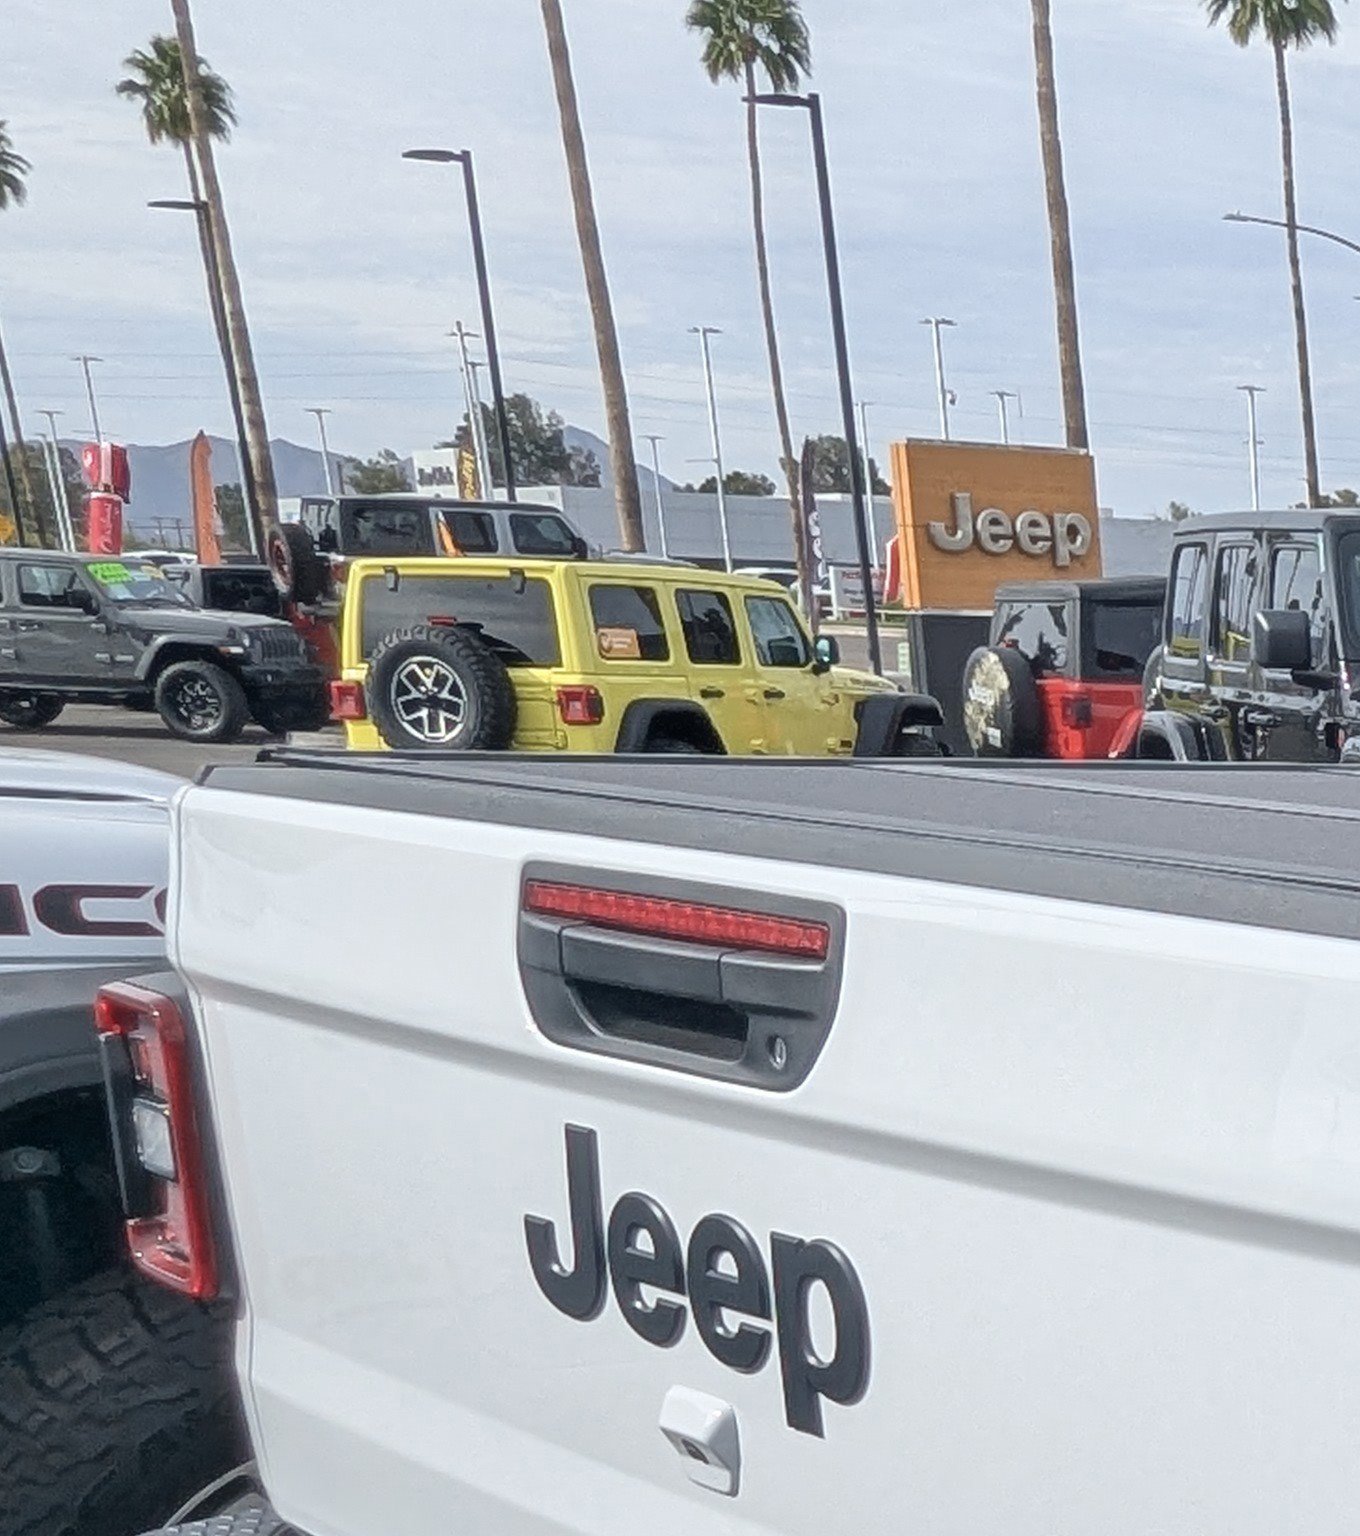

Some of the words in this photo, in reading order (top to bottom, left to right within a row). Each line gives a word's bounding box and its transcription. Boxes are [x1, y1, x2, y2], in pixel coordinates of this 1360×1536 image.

[926, 491, 1092, 567] Jeep
[0, 883, 168, 937] IC
[523, 1121, 873, 1440] Jeep
